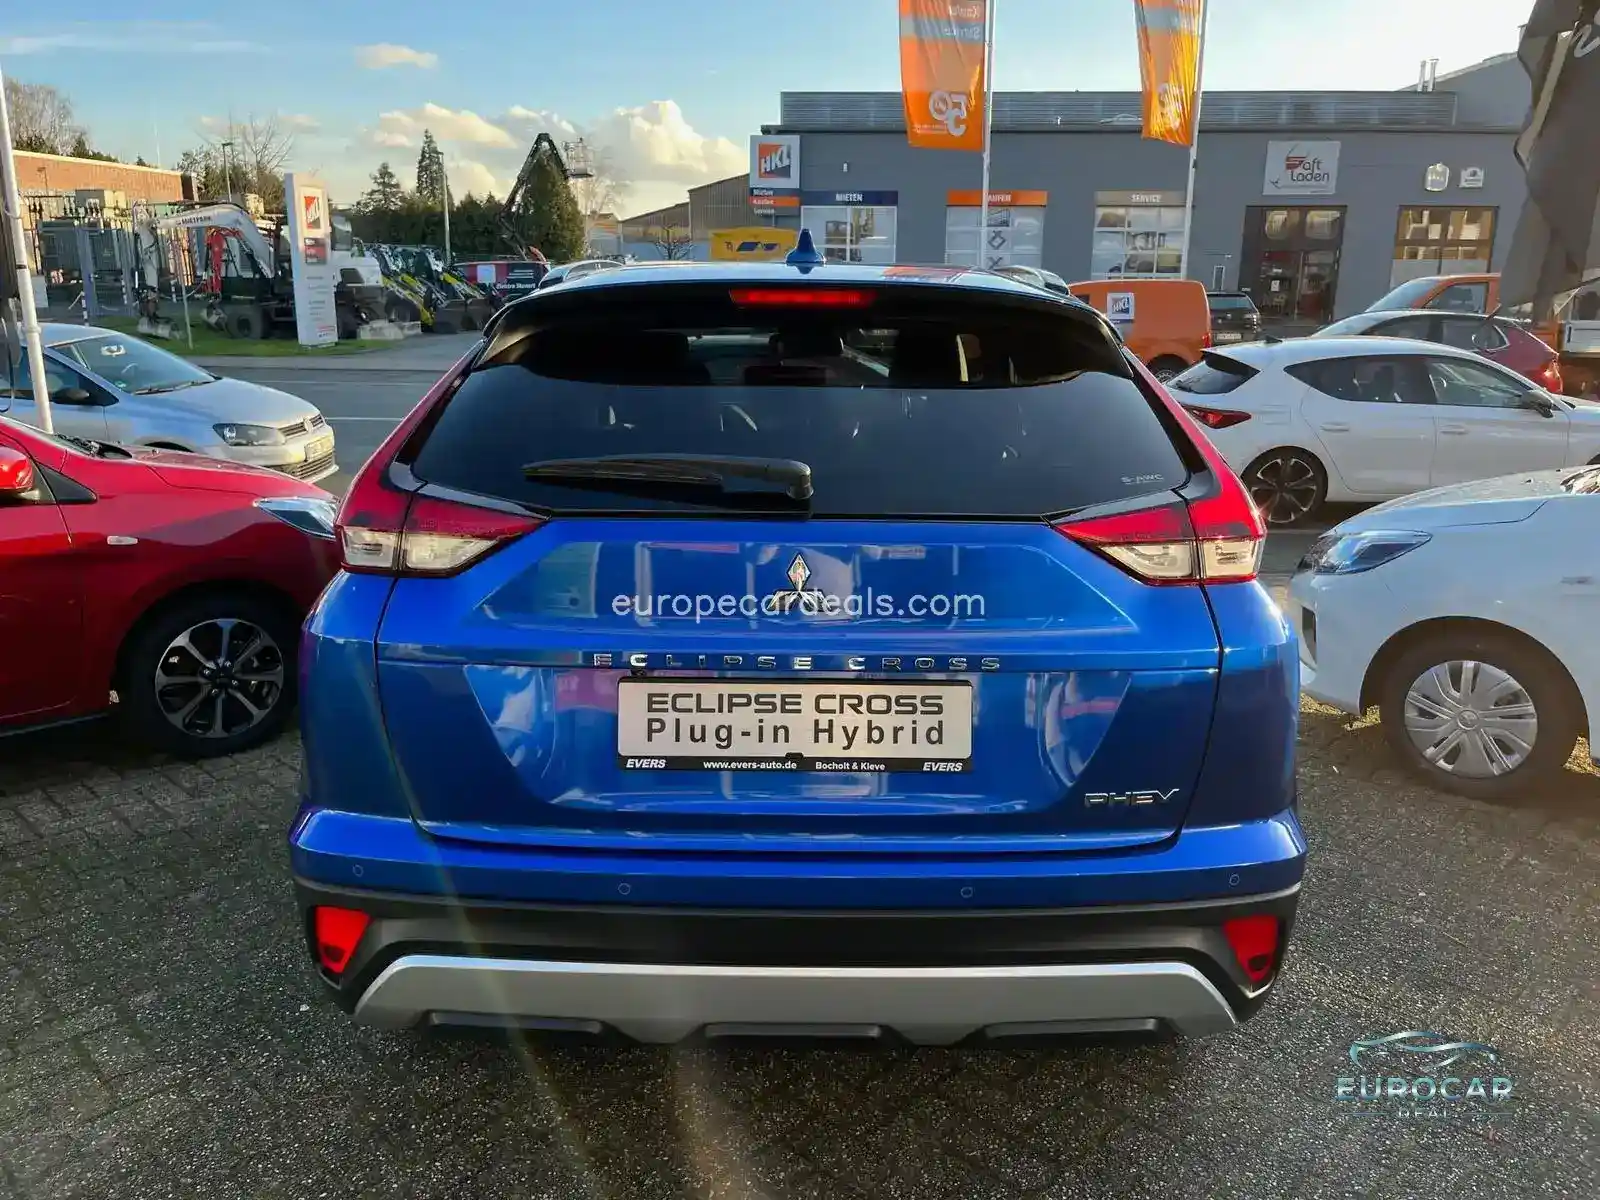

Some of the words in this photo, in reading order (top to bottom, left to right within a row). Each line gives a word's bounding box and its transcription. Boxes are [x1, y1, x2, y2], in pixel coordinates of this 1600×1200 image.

[1132, 193, 1161, 203] SERVICE
[593, 653, 813, 670] ECLIPSE
[847, 657, 1000, 671] CROSS
[647, 692, 802, 714] ECLIPSE
[814, 694, 944, 715] CROSS
[647, 717, 790, 749] Plug-in
[813, 719, 944, 750] Hybrid
[626, 758, 666, 769] EVERS
[703, 759, 797, 771] www.evers-auto.de
[815, 761, 849, 771] Bocholt
[851, 761, 859, 771] &
[861, 761, 886, 771] Kleve
[922, 762, 963, 772] EVERS
[1085, 788, 1180, 808] PHEV
